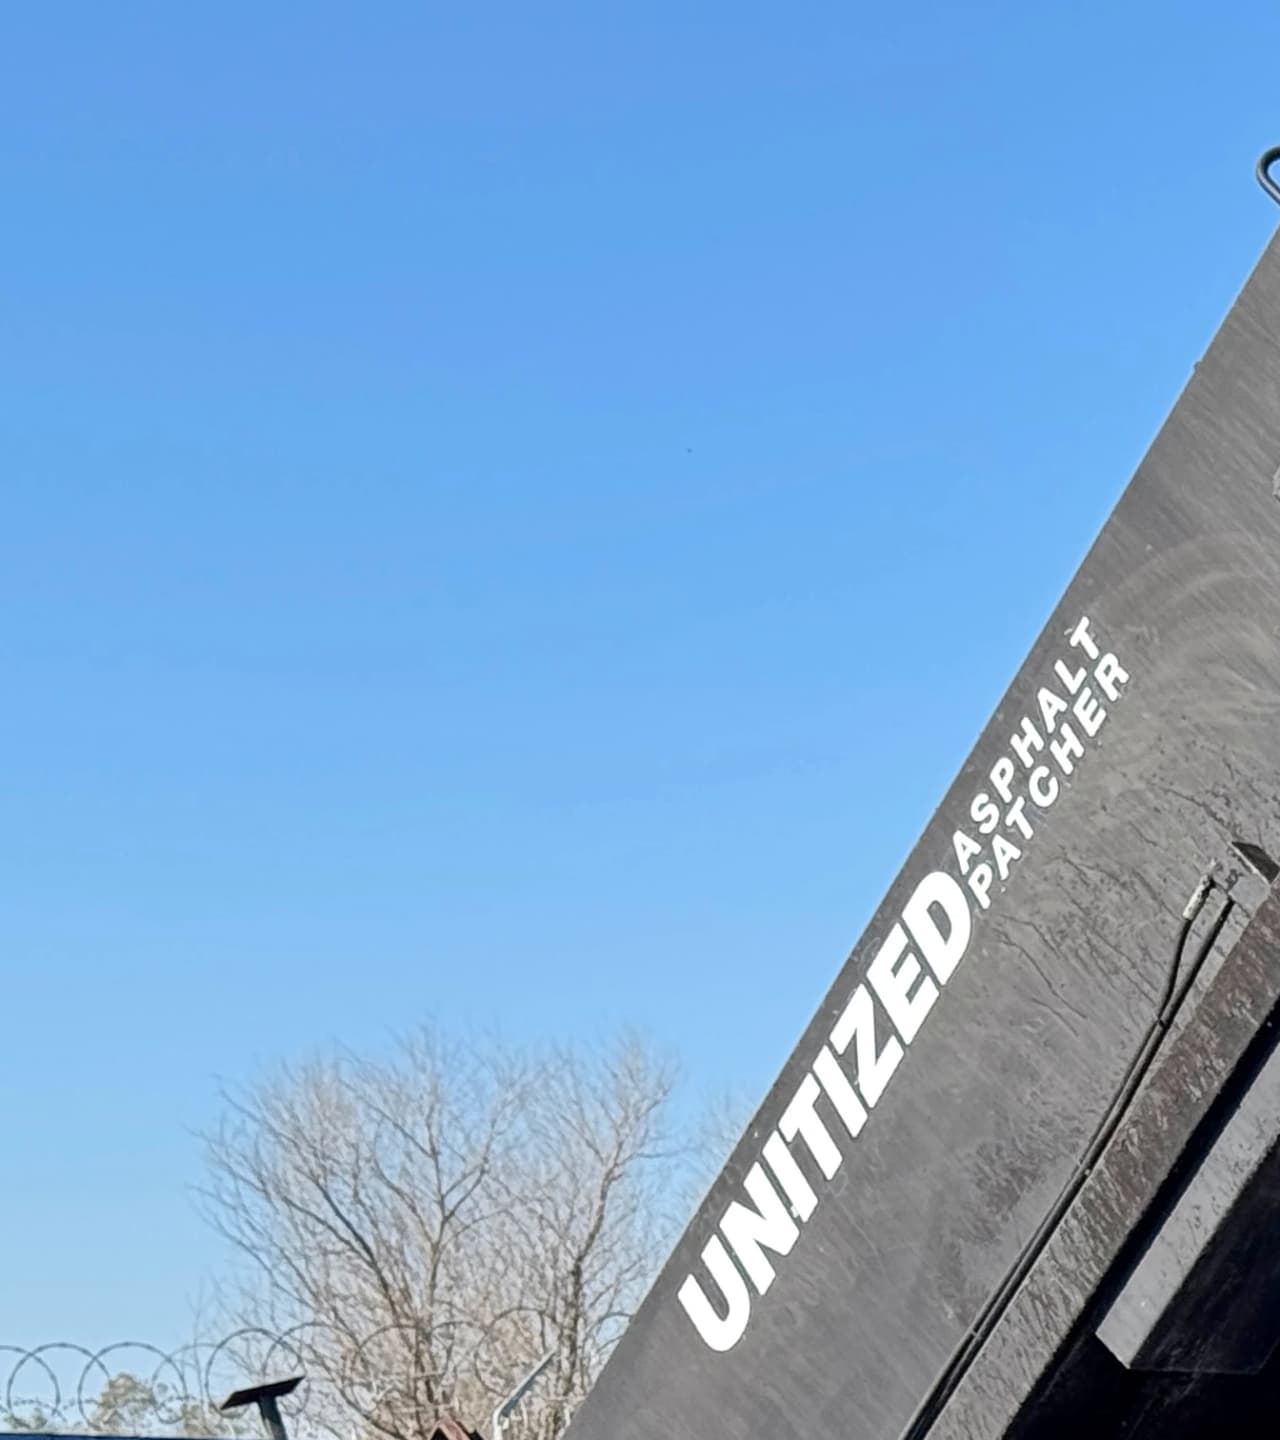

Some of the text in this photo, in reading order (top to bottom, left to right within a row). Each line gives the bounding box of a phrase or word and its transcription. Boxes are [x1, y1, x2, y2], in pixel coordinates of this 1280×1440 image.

[952, 615, 1100, 875] ASPHALT
[967, 653, 1129, 910] PATCHER
[677, 871, 972, 1352] UNITIZED
